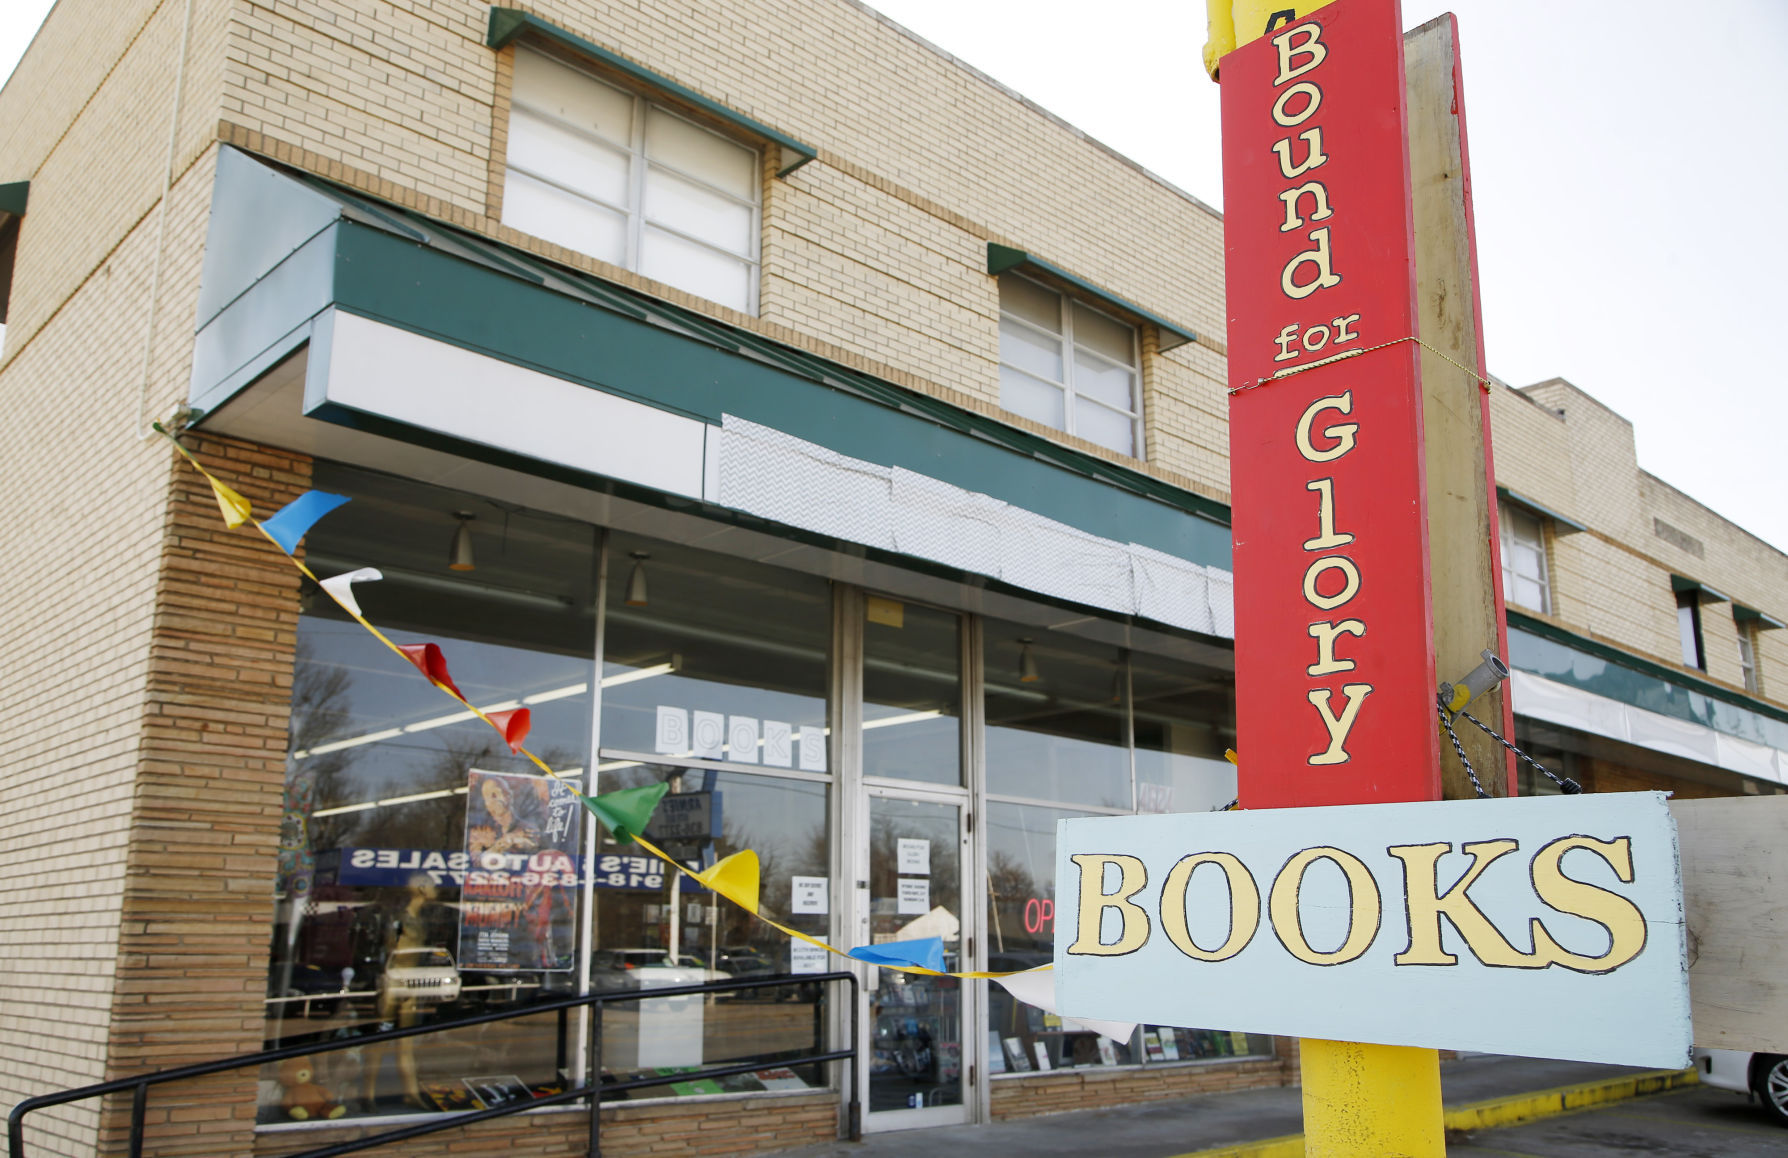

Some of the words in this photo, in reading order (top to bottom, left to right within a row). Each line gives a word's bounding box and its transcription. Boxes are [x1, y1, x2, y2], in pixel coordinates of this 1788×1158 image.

[1271, 20, 1343, 301] Bound
[1273, 312, 1362, 363] for
[1295, 388, 1375, 767] Glory
[661, 713, 824, 764] BOOKS
[1024, 897, 1055, 933] OP
[1067, 833, 1648, 975] BOOKS
